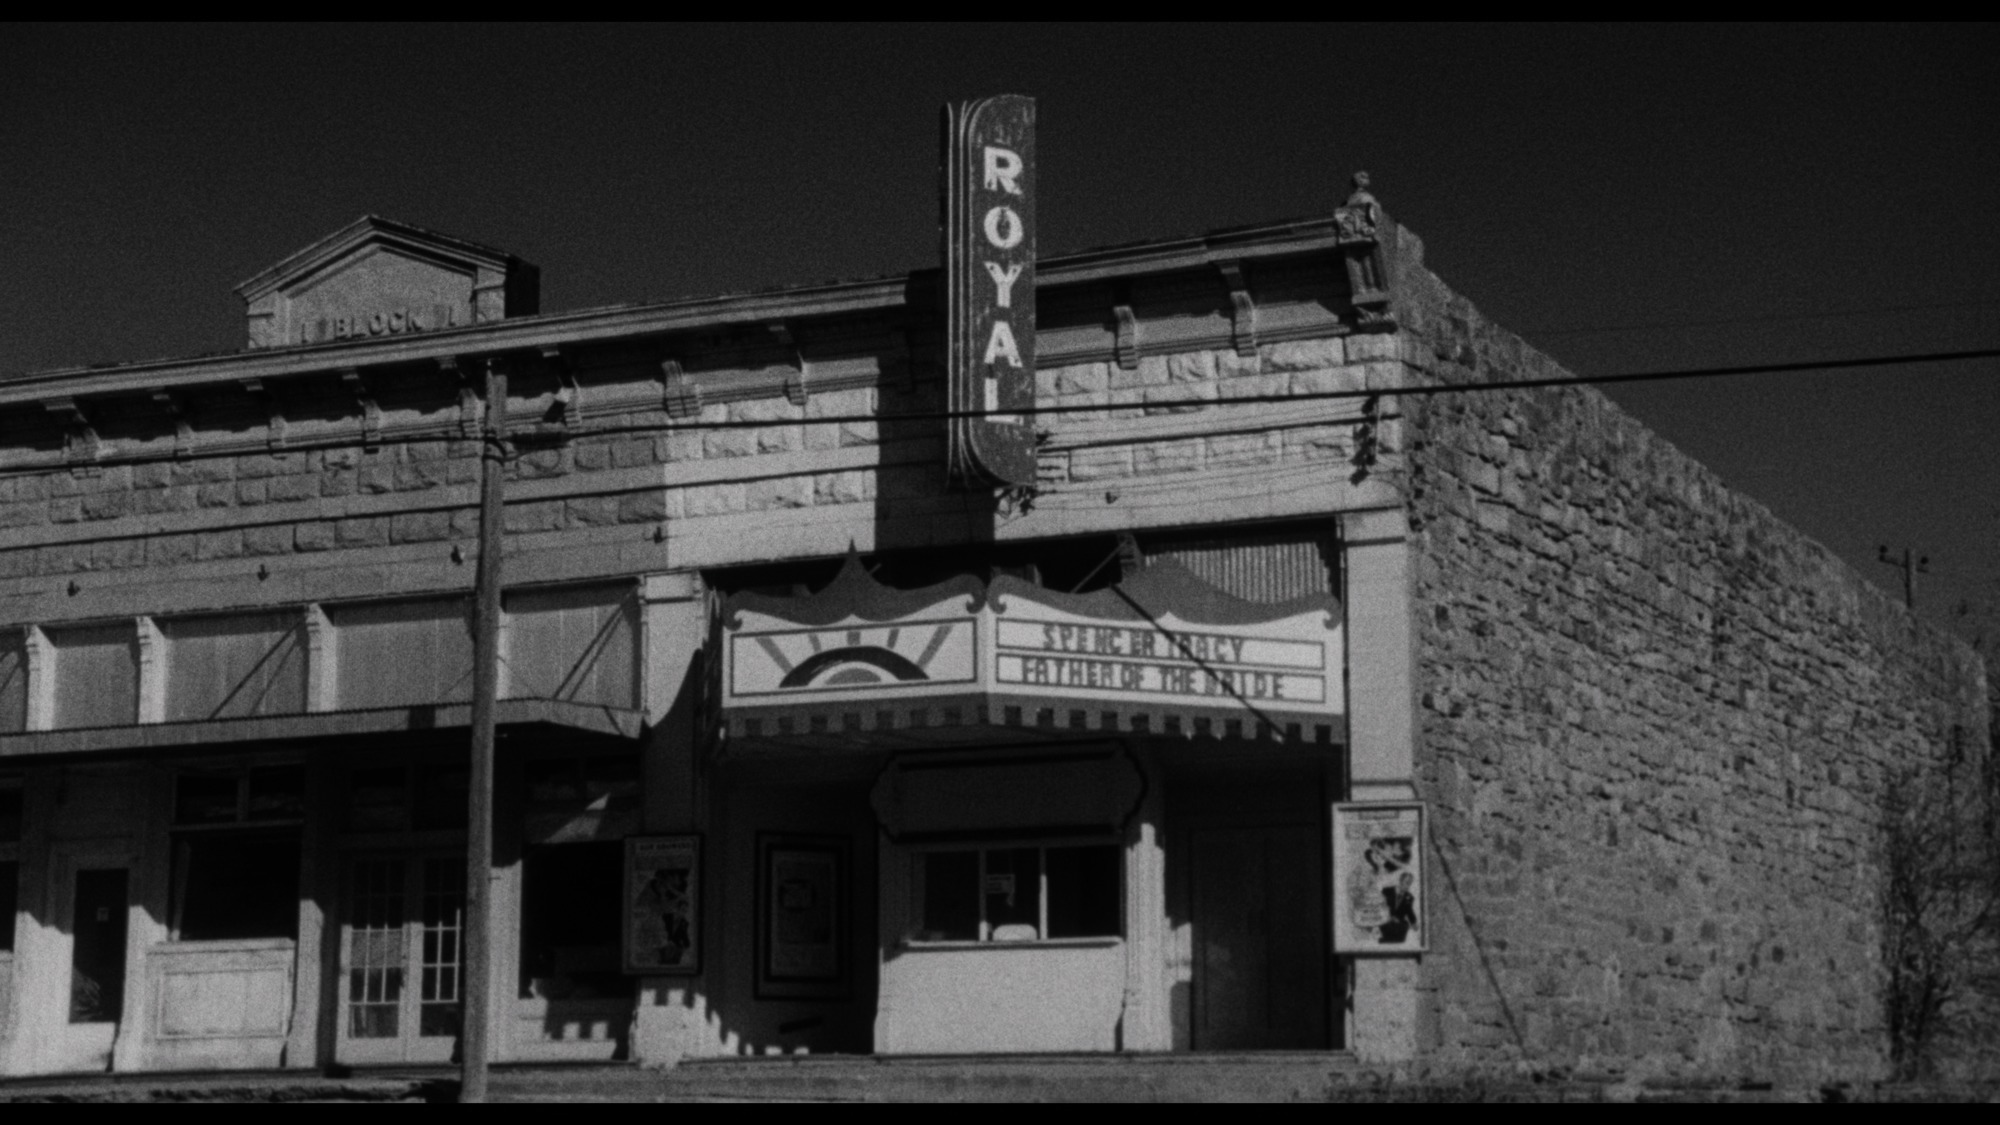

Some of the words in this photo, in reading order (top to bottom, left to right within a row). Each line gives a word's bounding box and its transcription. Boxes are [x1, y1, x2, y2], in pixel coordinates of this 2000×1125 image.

[984, 146, 1024, 426] ROYAL
[333, 309, 422, 341] BLOCK
[1043, 624, 1154, 656] SPENCER
[1167, 632, 1245, 663] TRACY
[1021, 657, 1113, 687] FATHER
[1121, 663, 1144, 690] OF
[1160, 666, 1196, 694] THE
[1205, 669, 1285, 699] BRIDE
